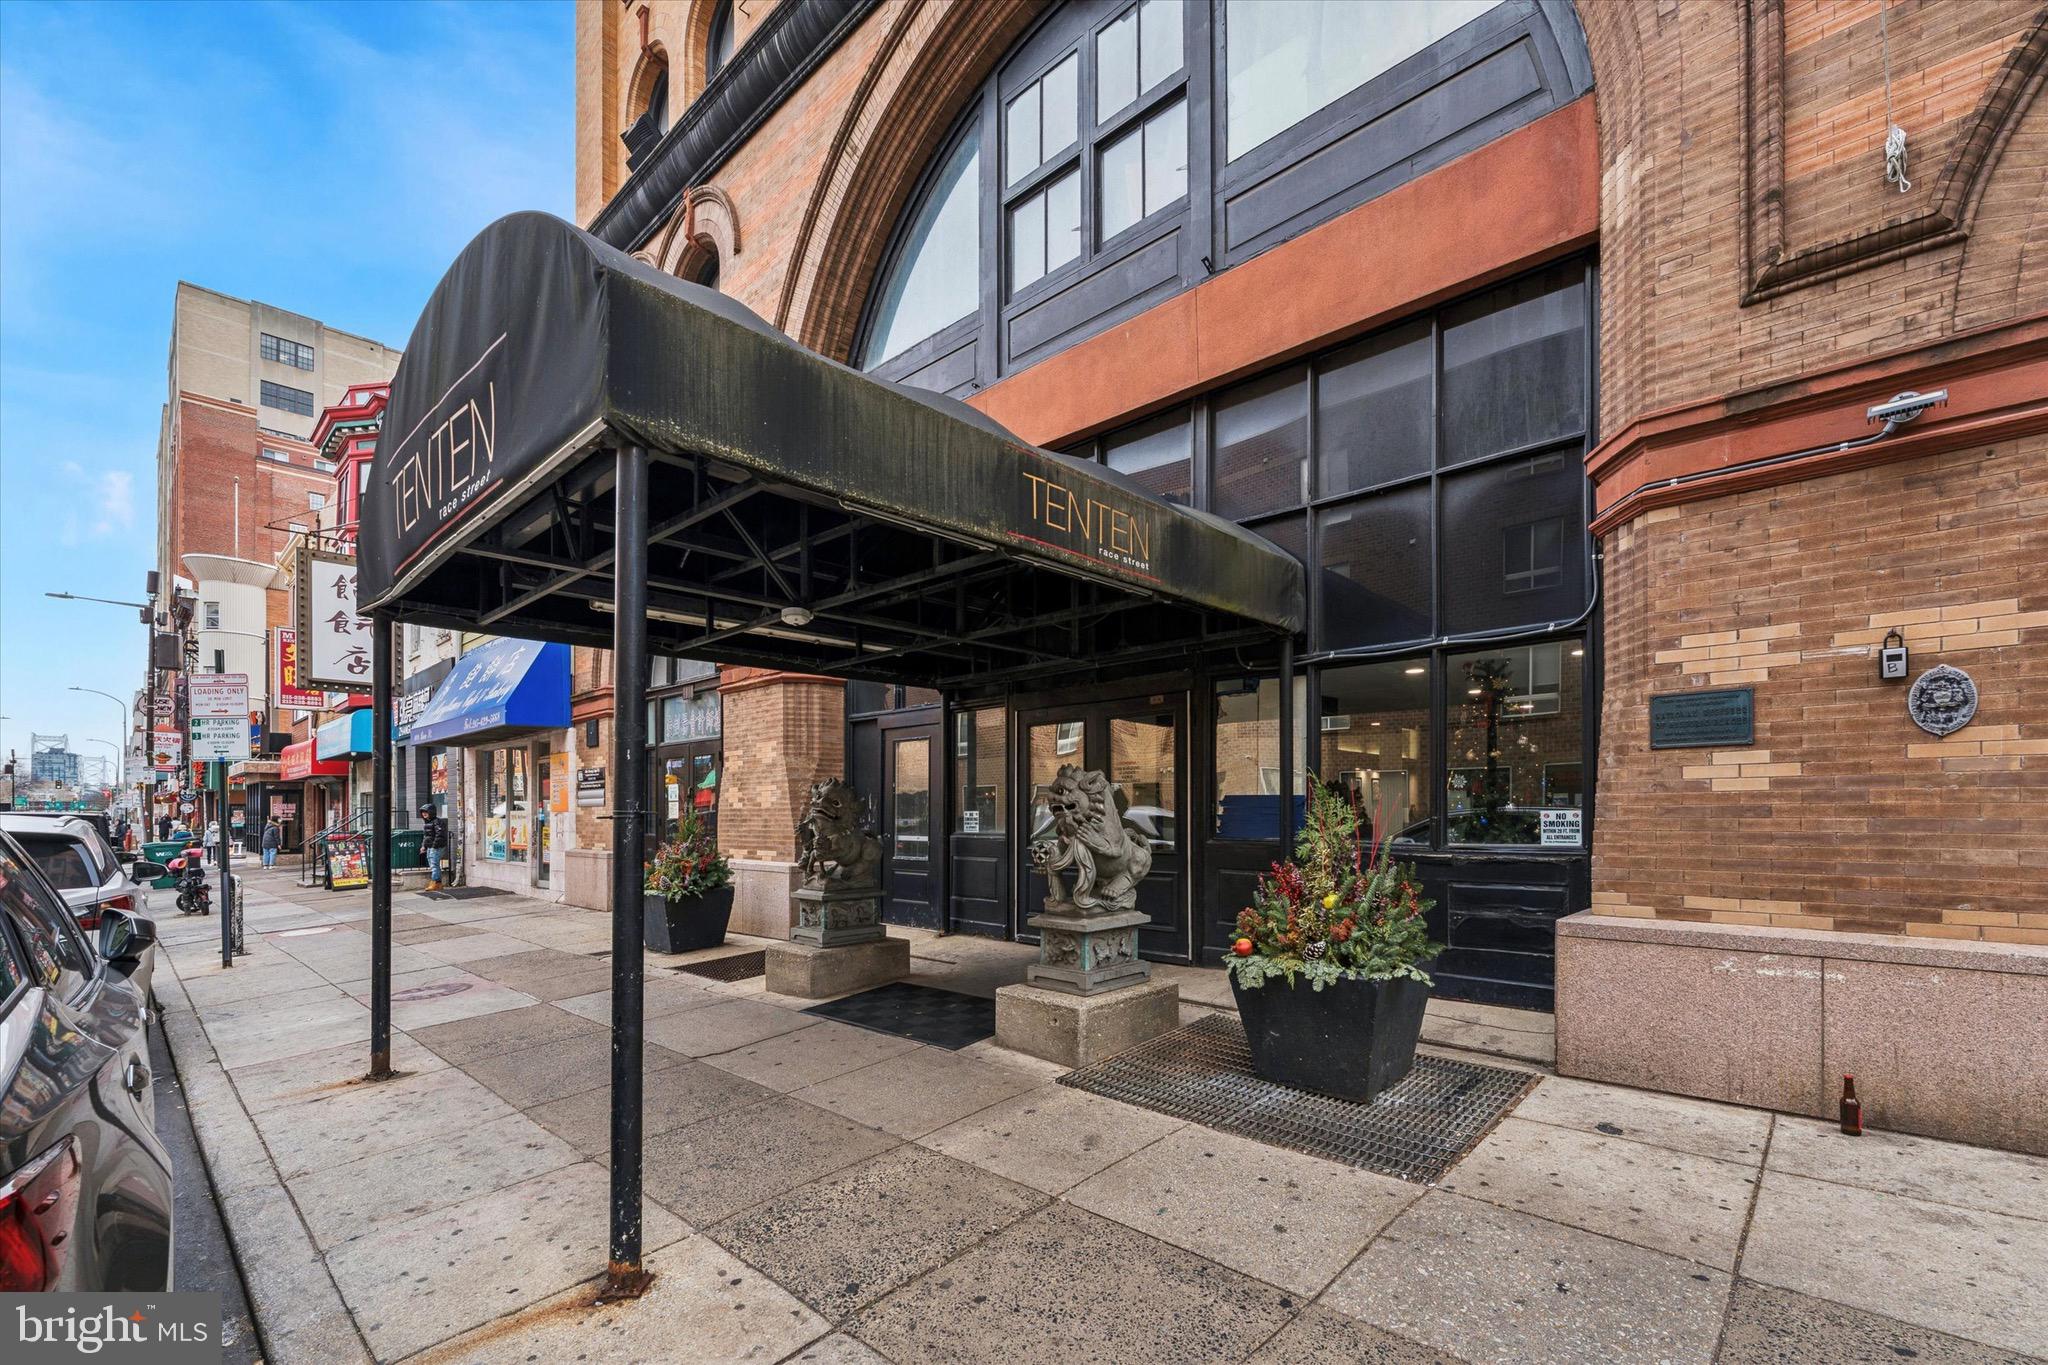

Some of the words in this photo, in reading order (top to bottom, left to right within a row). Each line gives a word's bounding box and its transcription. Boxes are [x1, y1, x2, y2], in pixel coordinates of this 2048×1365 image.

[392, 381, 495, 539] TENTEN
[439, 496, 458, 520] race
[461, 468, 491, 502] street
[1023, 472, 1149, 560] TENTEN
[1099, 548, 1119, 560] race
[1123, 556, 1150, 571] street
[1887, 662, 1898, 673] B
[1543, 820, 1580, 828] SMOKING
